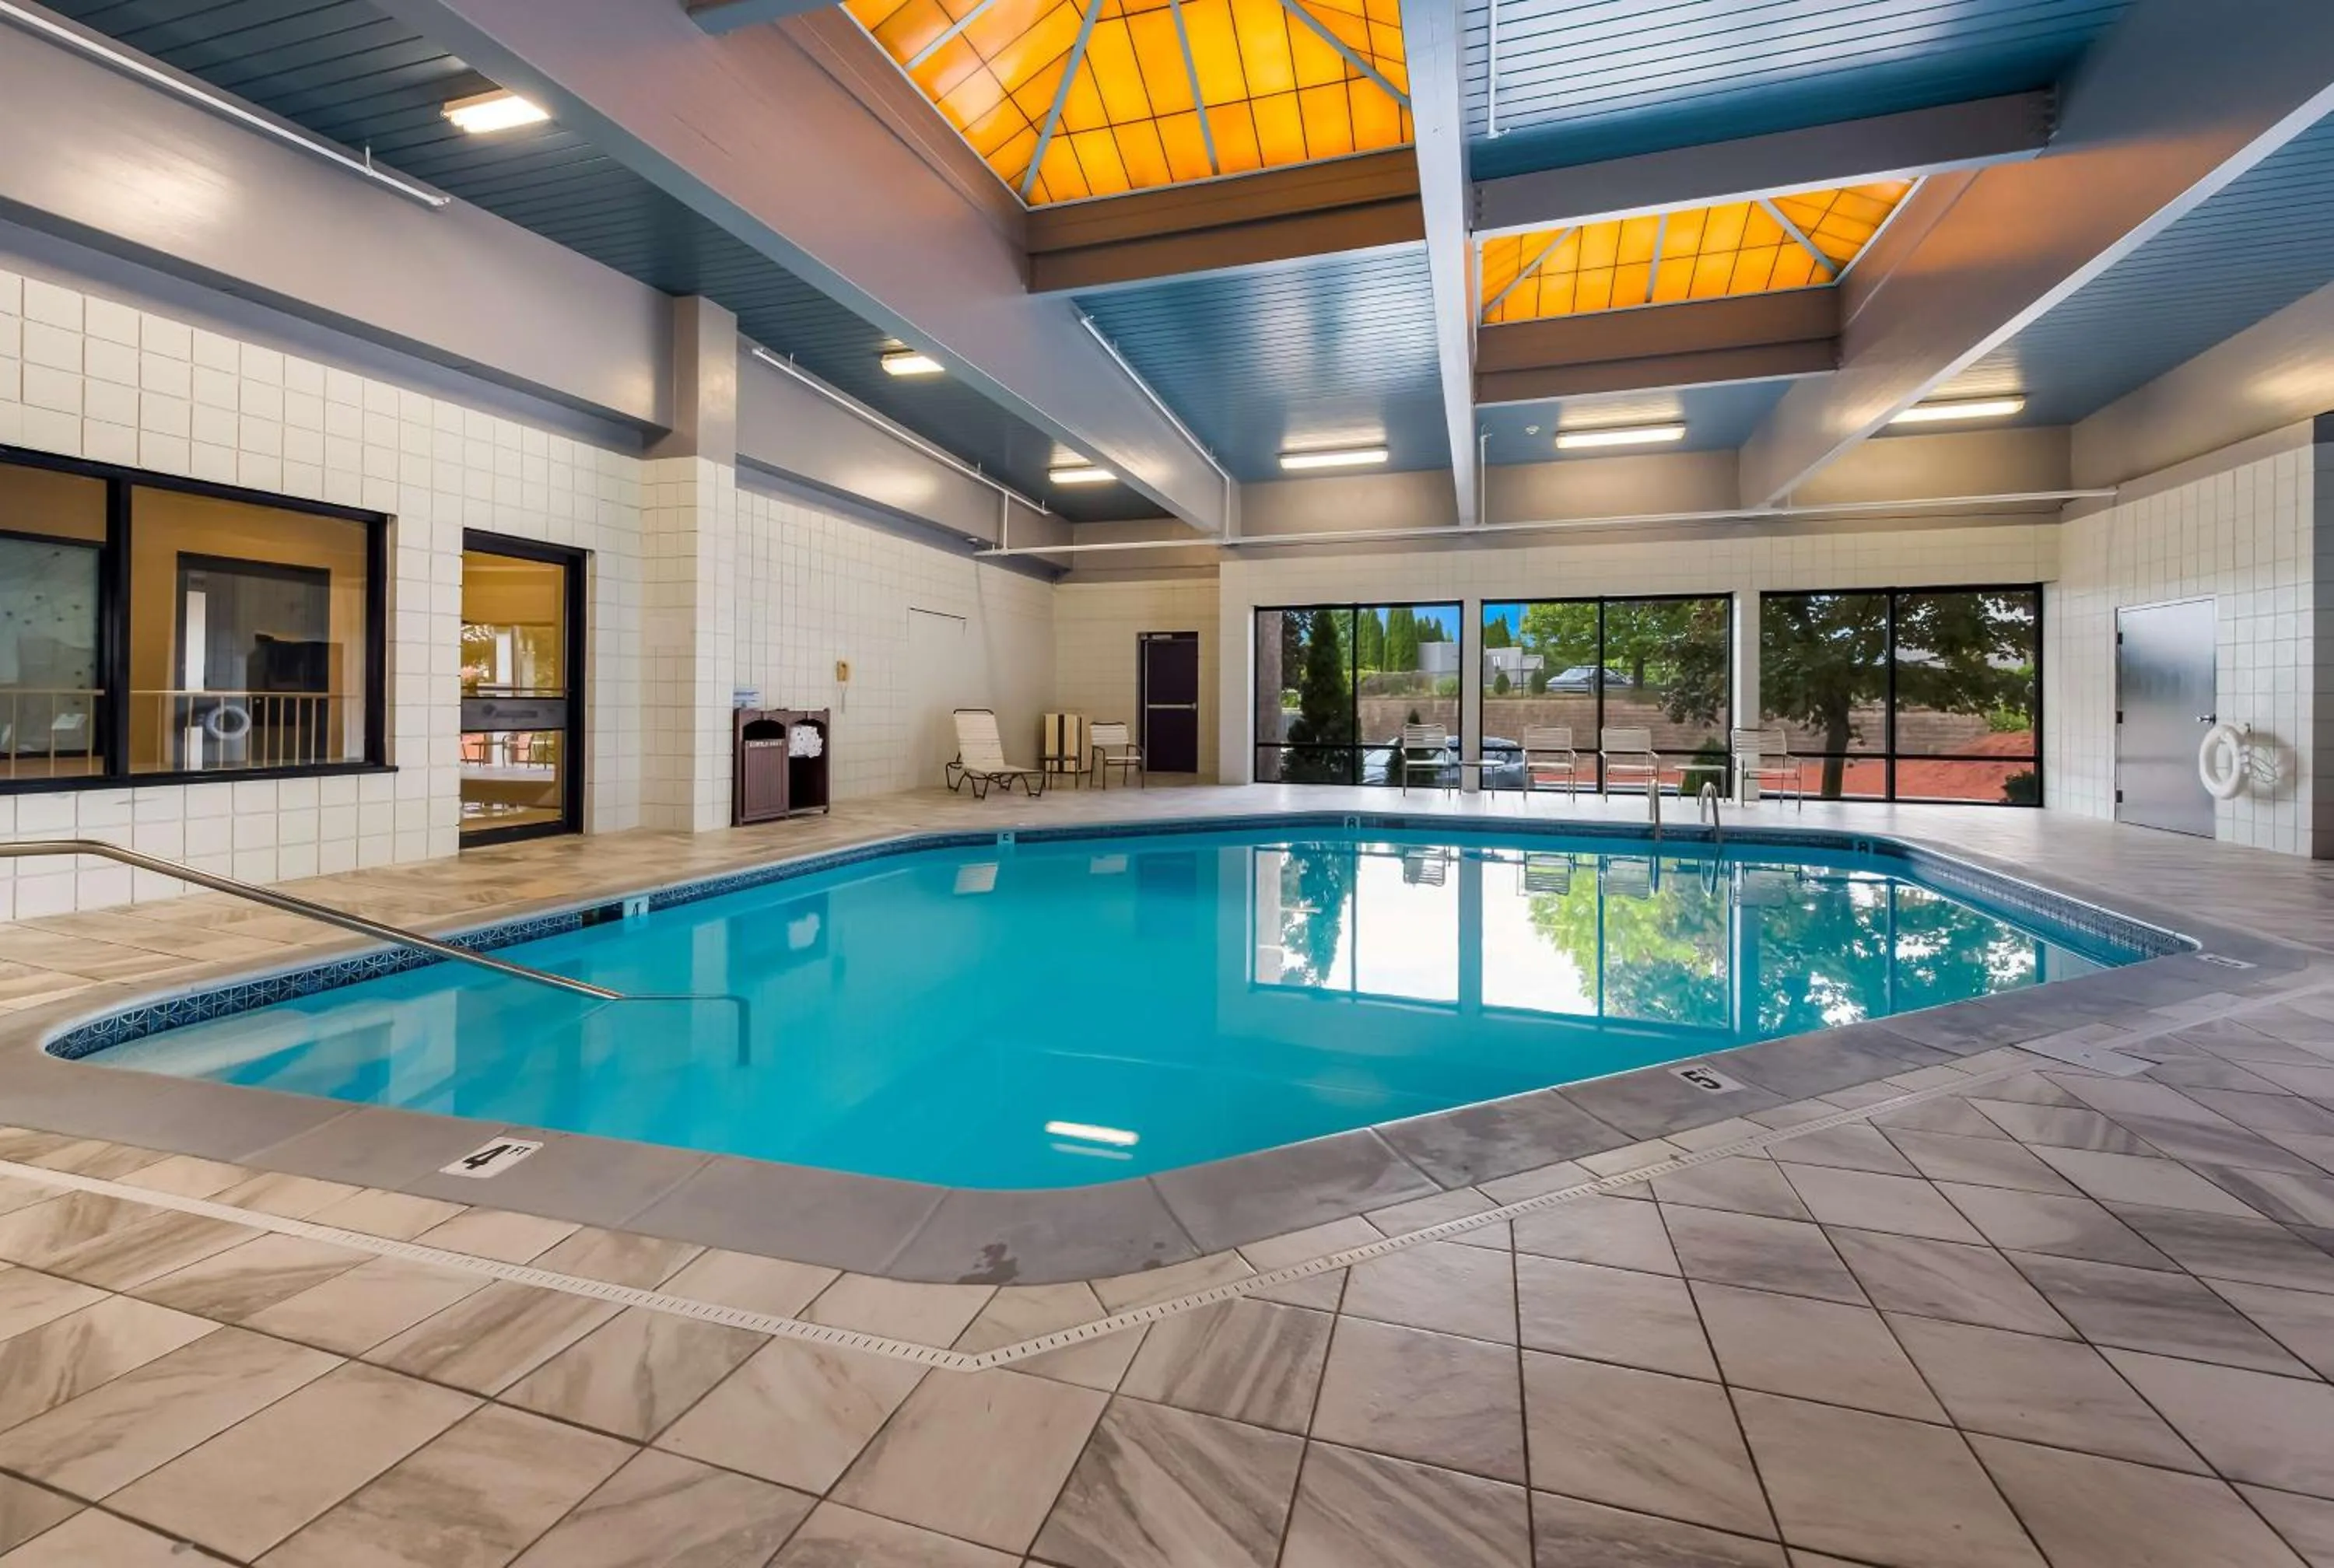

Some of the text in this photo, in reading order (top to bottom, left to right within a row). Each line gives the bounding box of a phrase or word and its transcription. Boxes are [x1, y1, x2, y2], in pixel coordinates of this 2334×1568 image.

[1680, 1070, 1722, 1090] 5
[462, 1144, 532, 1170] 4 FT
